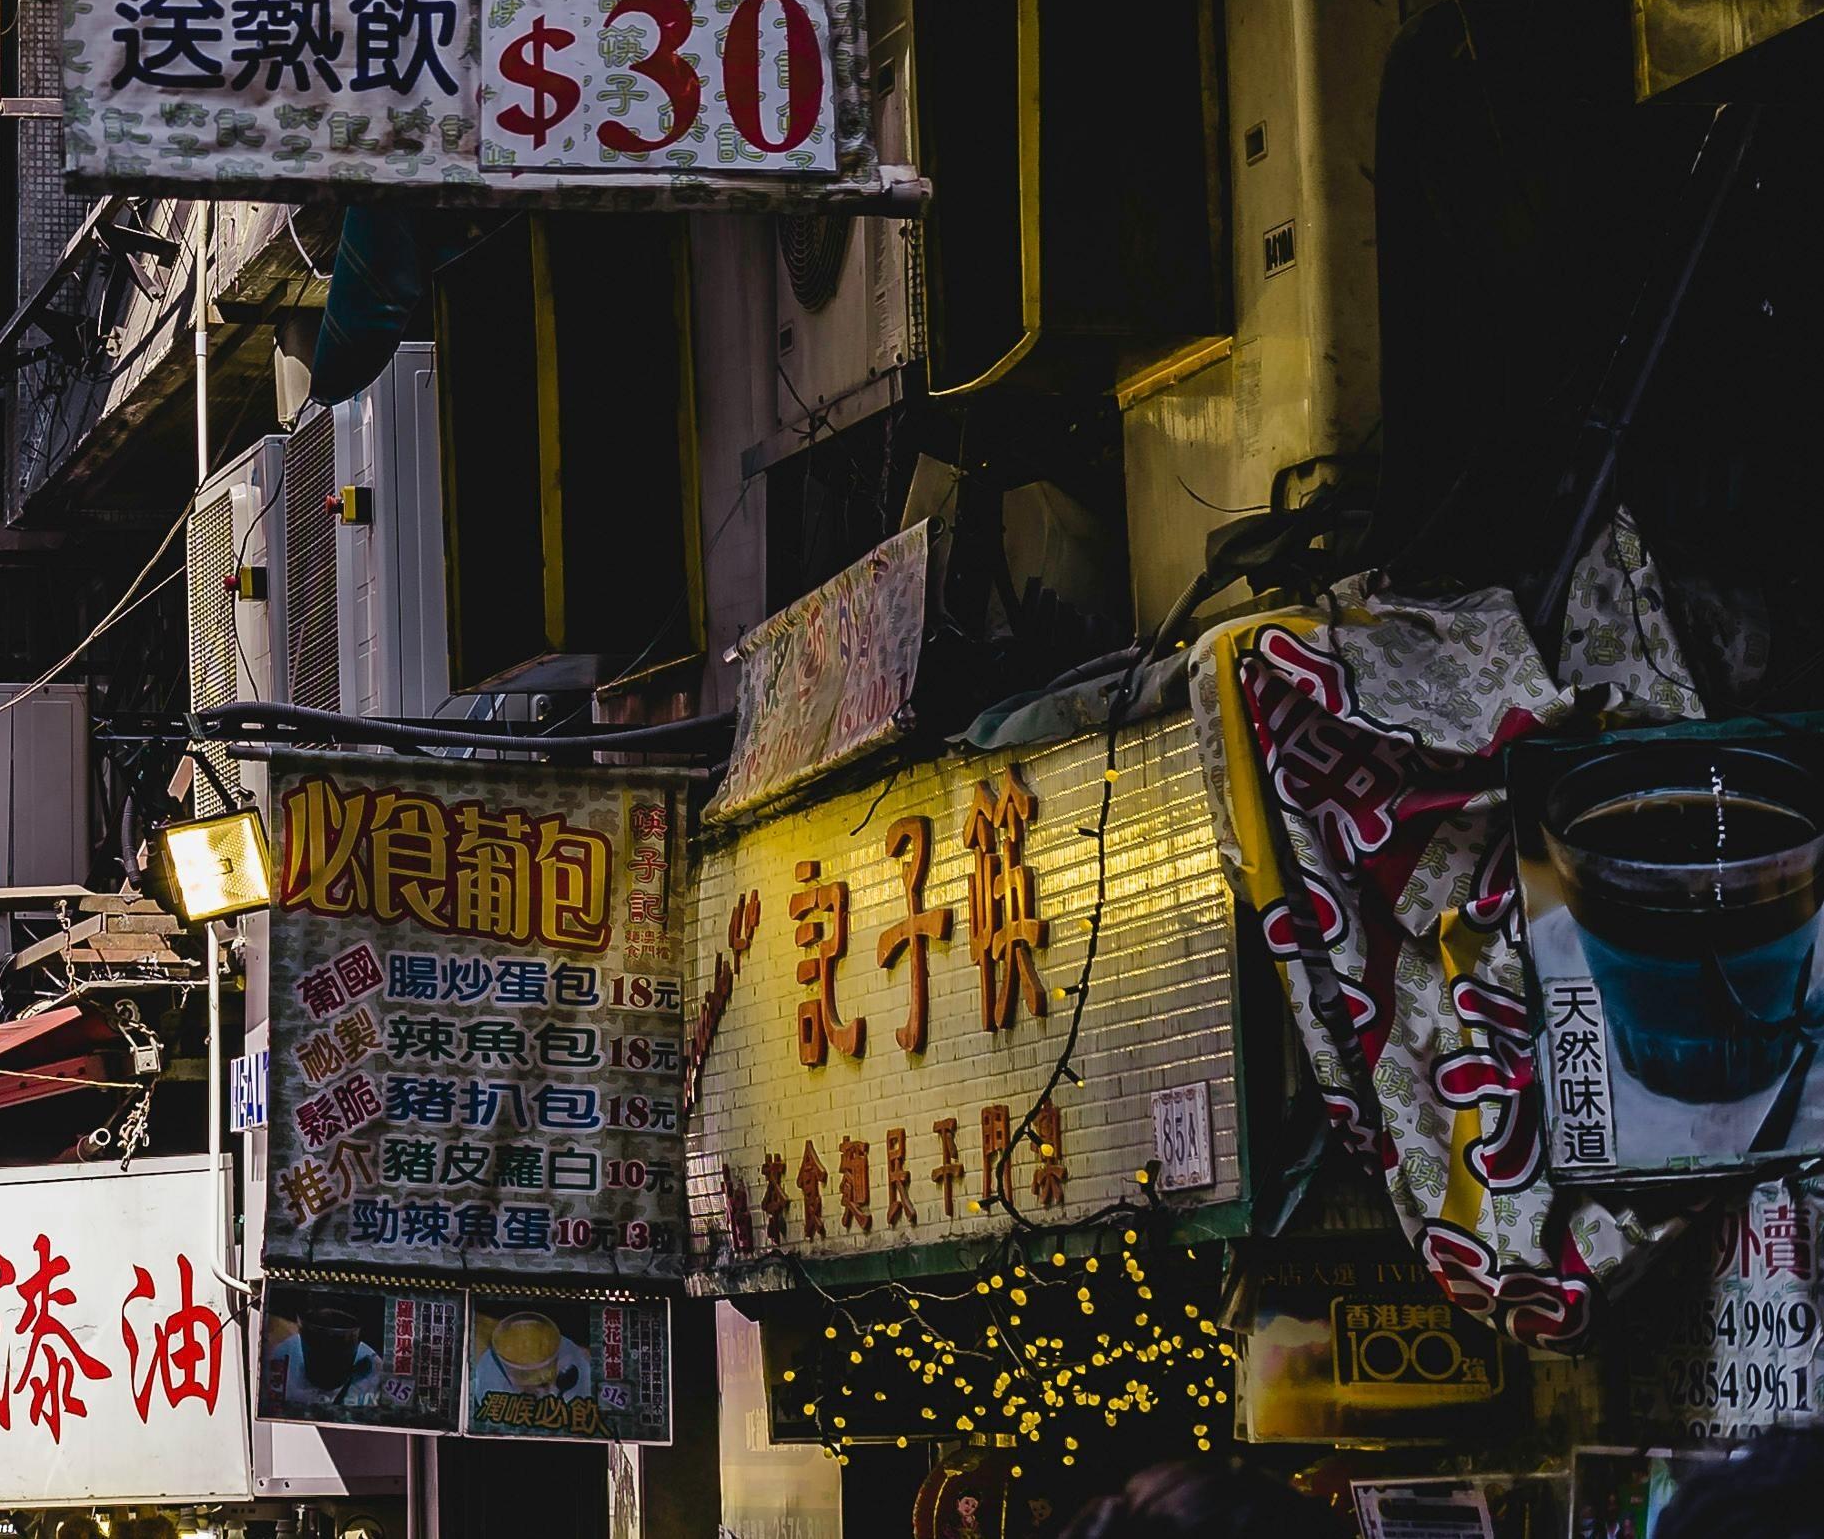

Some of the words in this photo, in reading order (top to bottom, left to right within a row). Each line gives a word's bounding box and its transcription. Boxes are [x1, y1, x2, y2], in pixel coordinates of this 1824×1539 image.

[630, 804, 668, 925] 筷子記
[388, 1017, 600, 1067] 辣魚包
[1552, 985, 1610, 1165] 天然味道
[1162, 1109, 1200, 1166] 85A
[1746, 1363, 1813, 1411] 9961
